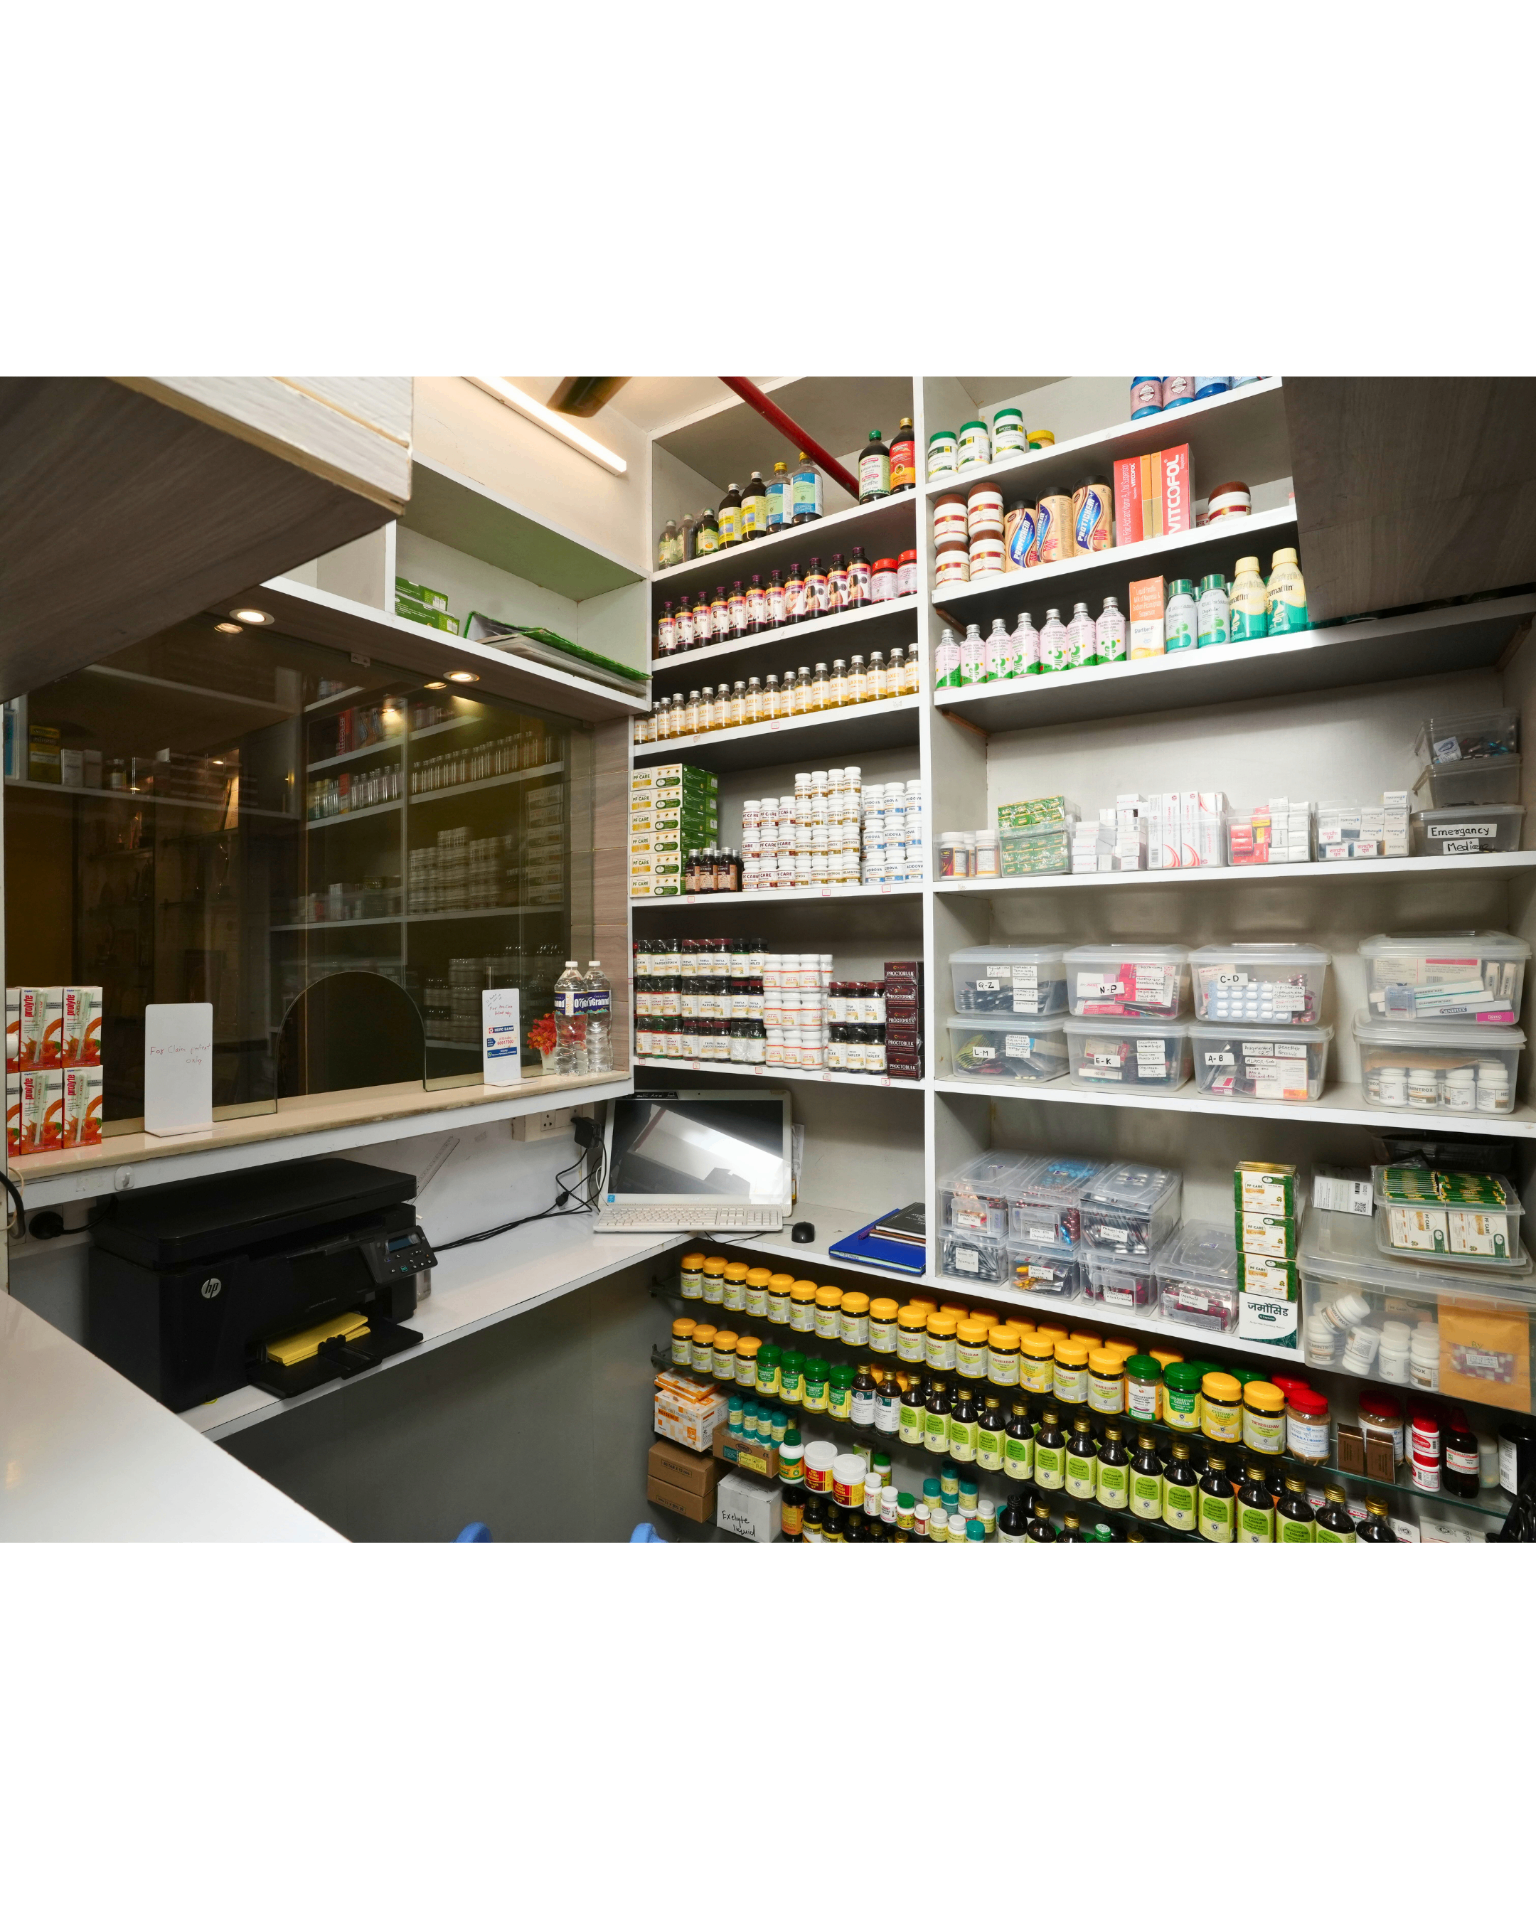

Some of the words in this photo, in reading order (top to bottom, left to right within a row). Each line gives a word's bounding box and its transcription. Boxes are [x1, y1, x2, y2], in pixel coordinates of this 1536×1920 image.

[1166, 454, 1181, 535] VITCOFOL
[1430, 827, 1490, 836] Emergancy
[1220, 974, 1240, 983] C-D
[24, 994, 34, 1018] prolyte
[66, 994, 76, 1016] prolyte
[25, 1078, 34, 1100] prolyte
[67, 1074, 76, 1096] prolyte
[204, 1280, 219, 1298] hp
